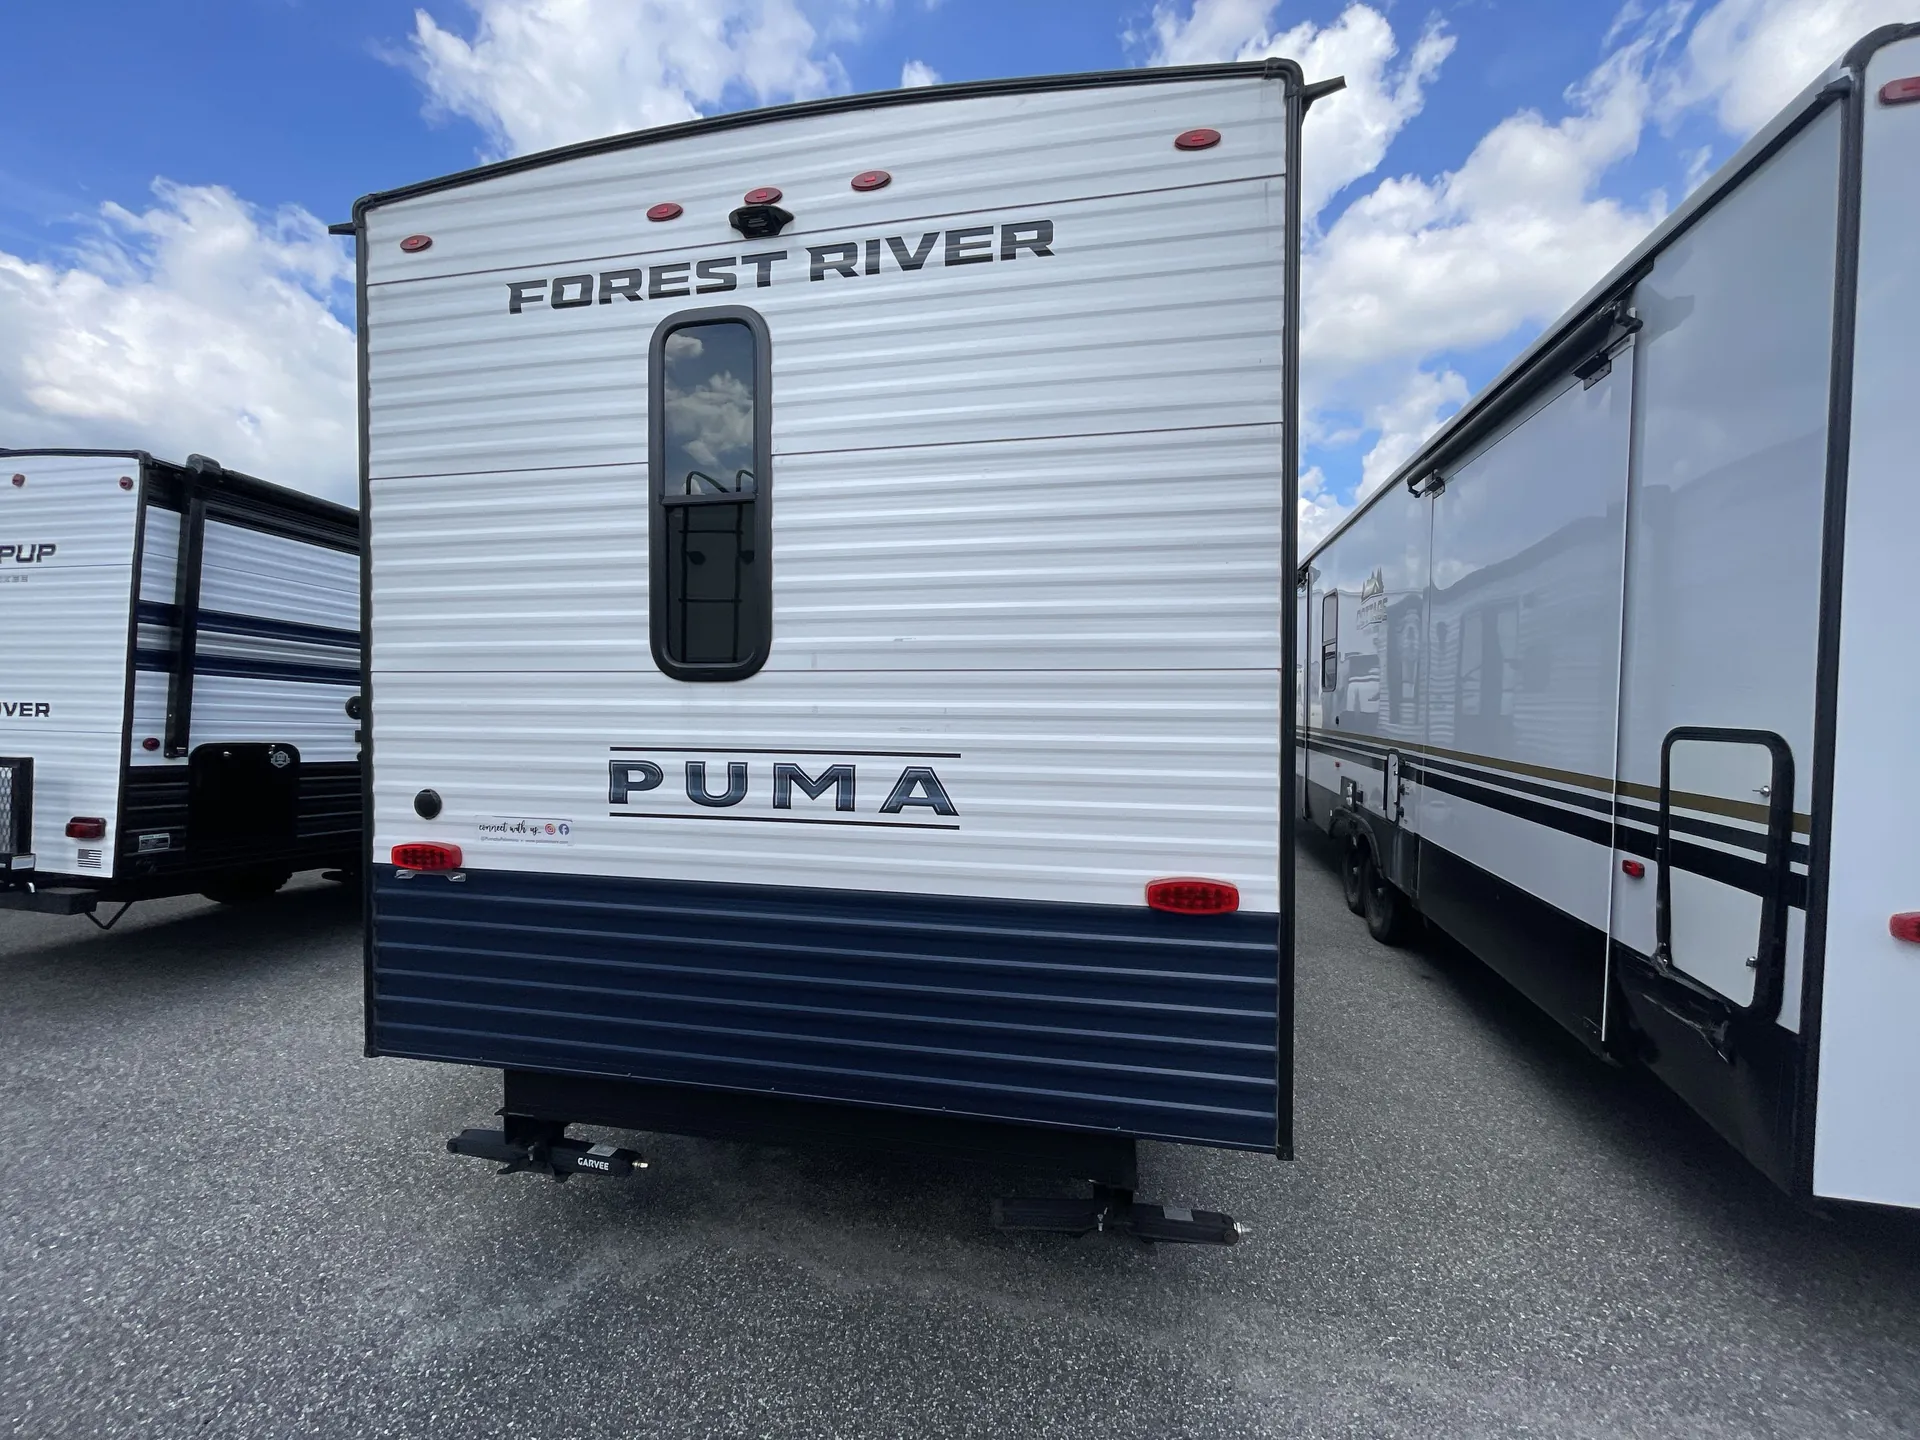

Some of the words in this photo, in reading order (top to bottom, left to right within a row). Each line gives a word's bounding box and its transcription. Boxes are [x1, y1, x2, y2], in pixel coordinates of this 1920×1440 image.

[506, 251, 788, 314] FOREST
[805, 219, 1056, 282] RIVER
[608, 760, 960, 817] PUMA
[479, 822, 508, 833] connect
[509, 820, 527, 834] with
[577, 1157, 610, 1171] GARVEE
